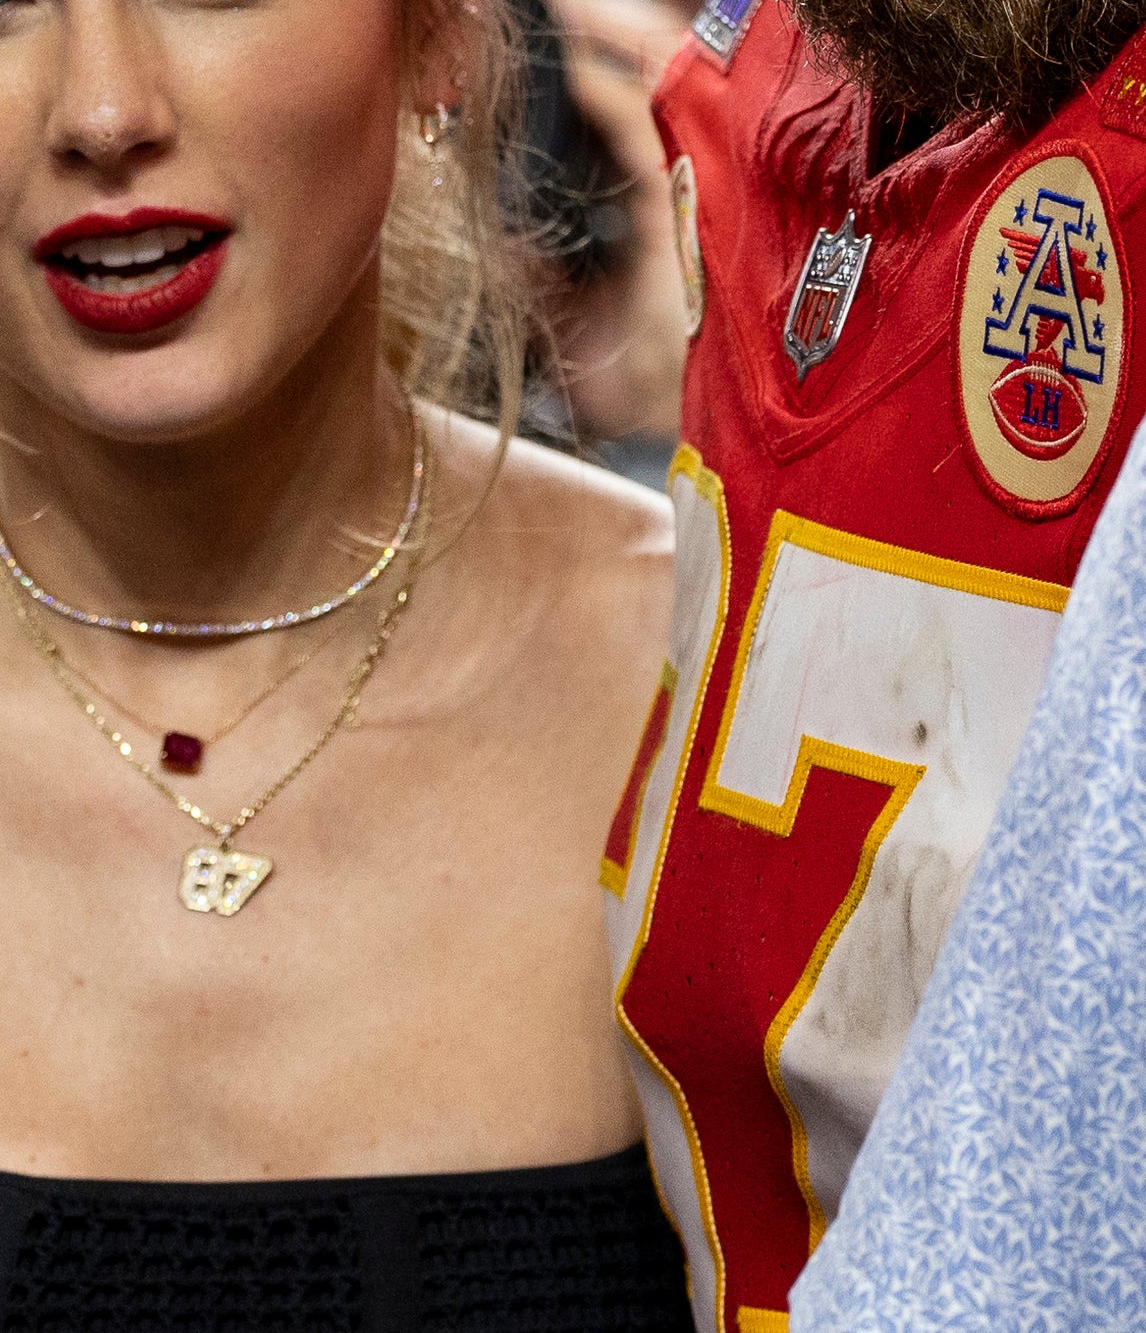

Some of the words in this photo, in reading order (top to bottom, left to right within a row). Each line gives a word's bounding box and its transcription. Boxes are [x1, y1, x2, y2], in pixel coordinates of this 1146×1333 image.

[983, 187, 1106, 385] A
[1020, 382, 1062, 430] LH
[178, 845, 274, 917] 87
